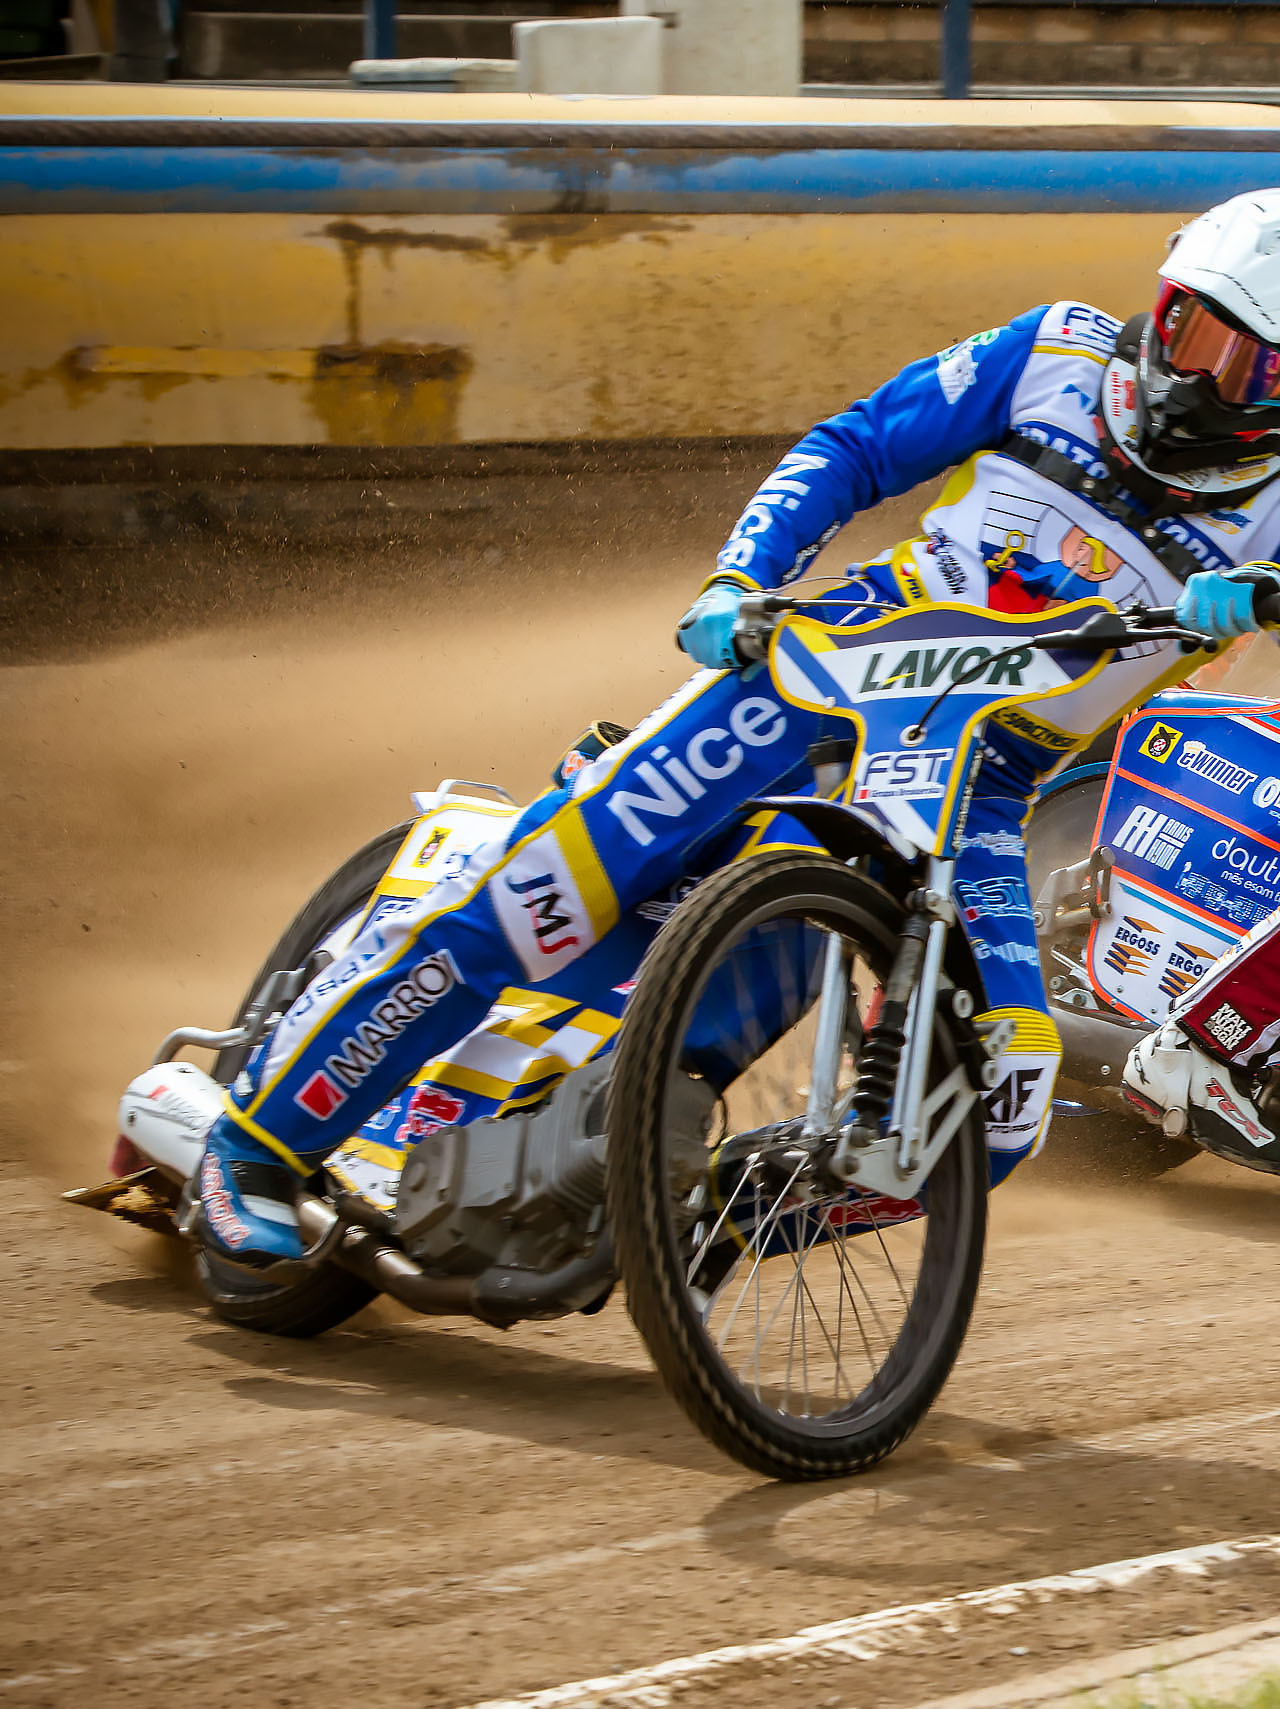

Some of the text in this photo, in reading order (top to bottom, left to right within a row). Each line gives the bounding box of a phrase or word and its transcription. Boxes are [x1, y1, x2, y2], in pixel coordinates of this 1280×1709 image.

[717, 453, 831, 570] Nice
[858, 647, 1033, 695] LAVOR
[606, 697, 787, 847] Nice
[862, 751, 950, 786] FST
[505, 872, 579, 955] JMS
[1244, 879, 1275, 901] esam
[1114, 926, 1161, 956] ERGOSS
